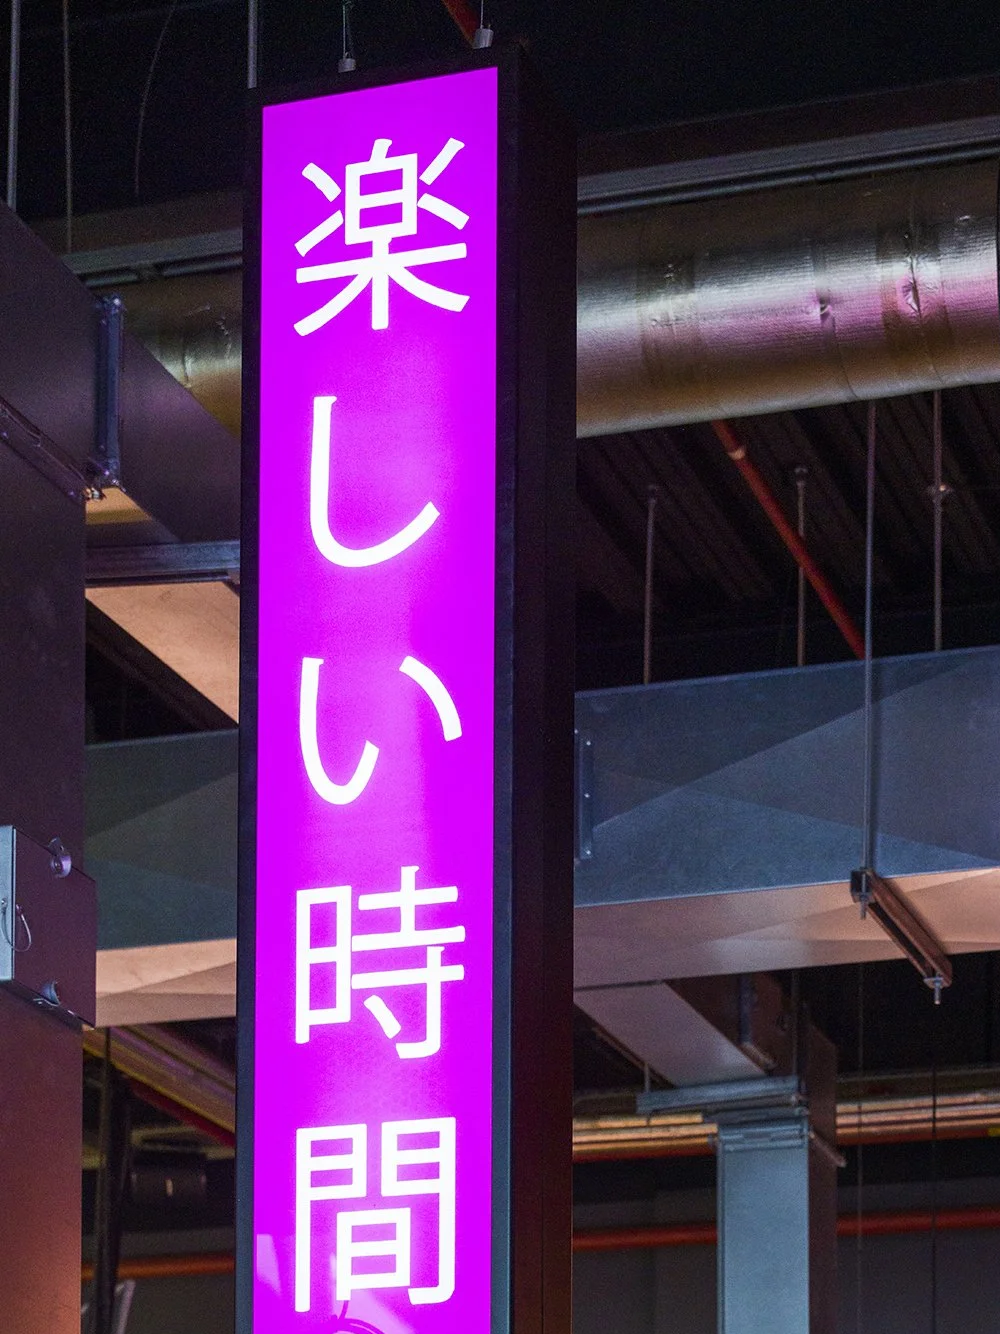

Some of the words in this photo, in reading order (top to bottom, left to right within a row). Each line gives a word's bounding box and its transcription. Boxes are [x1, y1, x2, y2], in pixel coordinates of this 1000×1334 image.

[294, 137, 469, 1312] 楽しい時間
